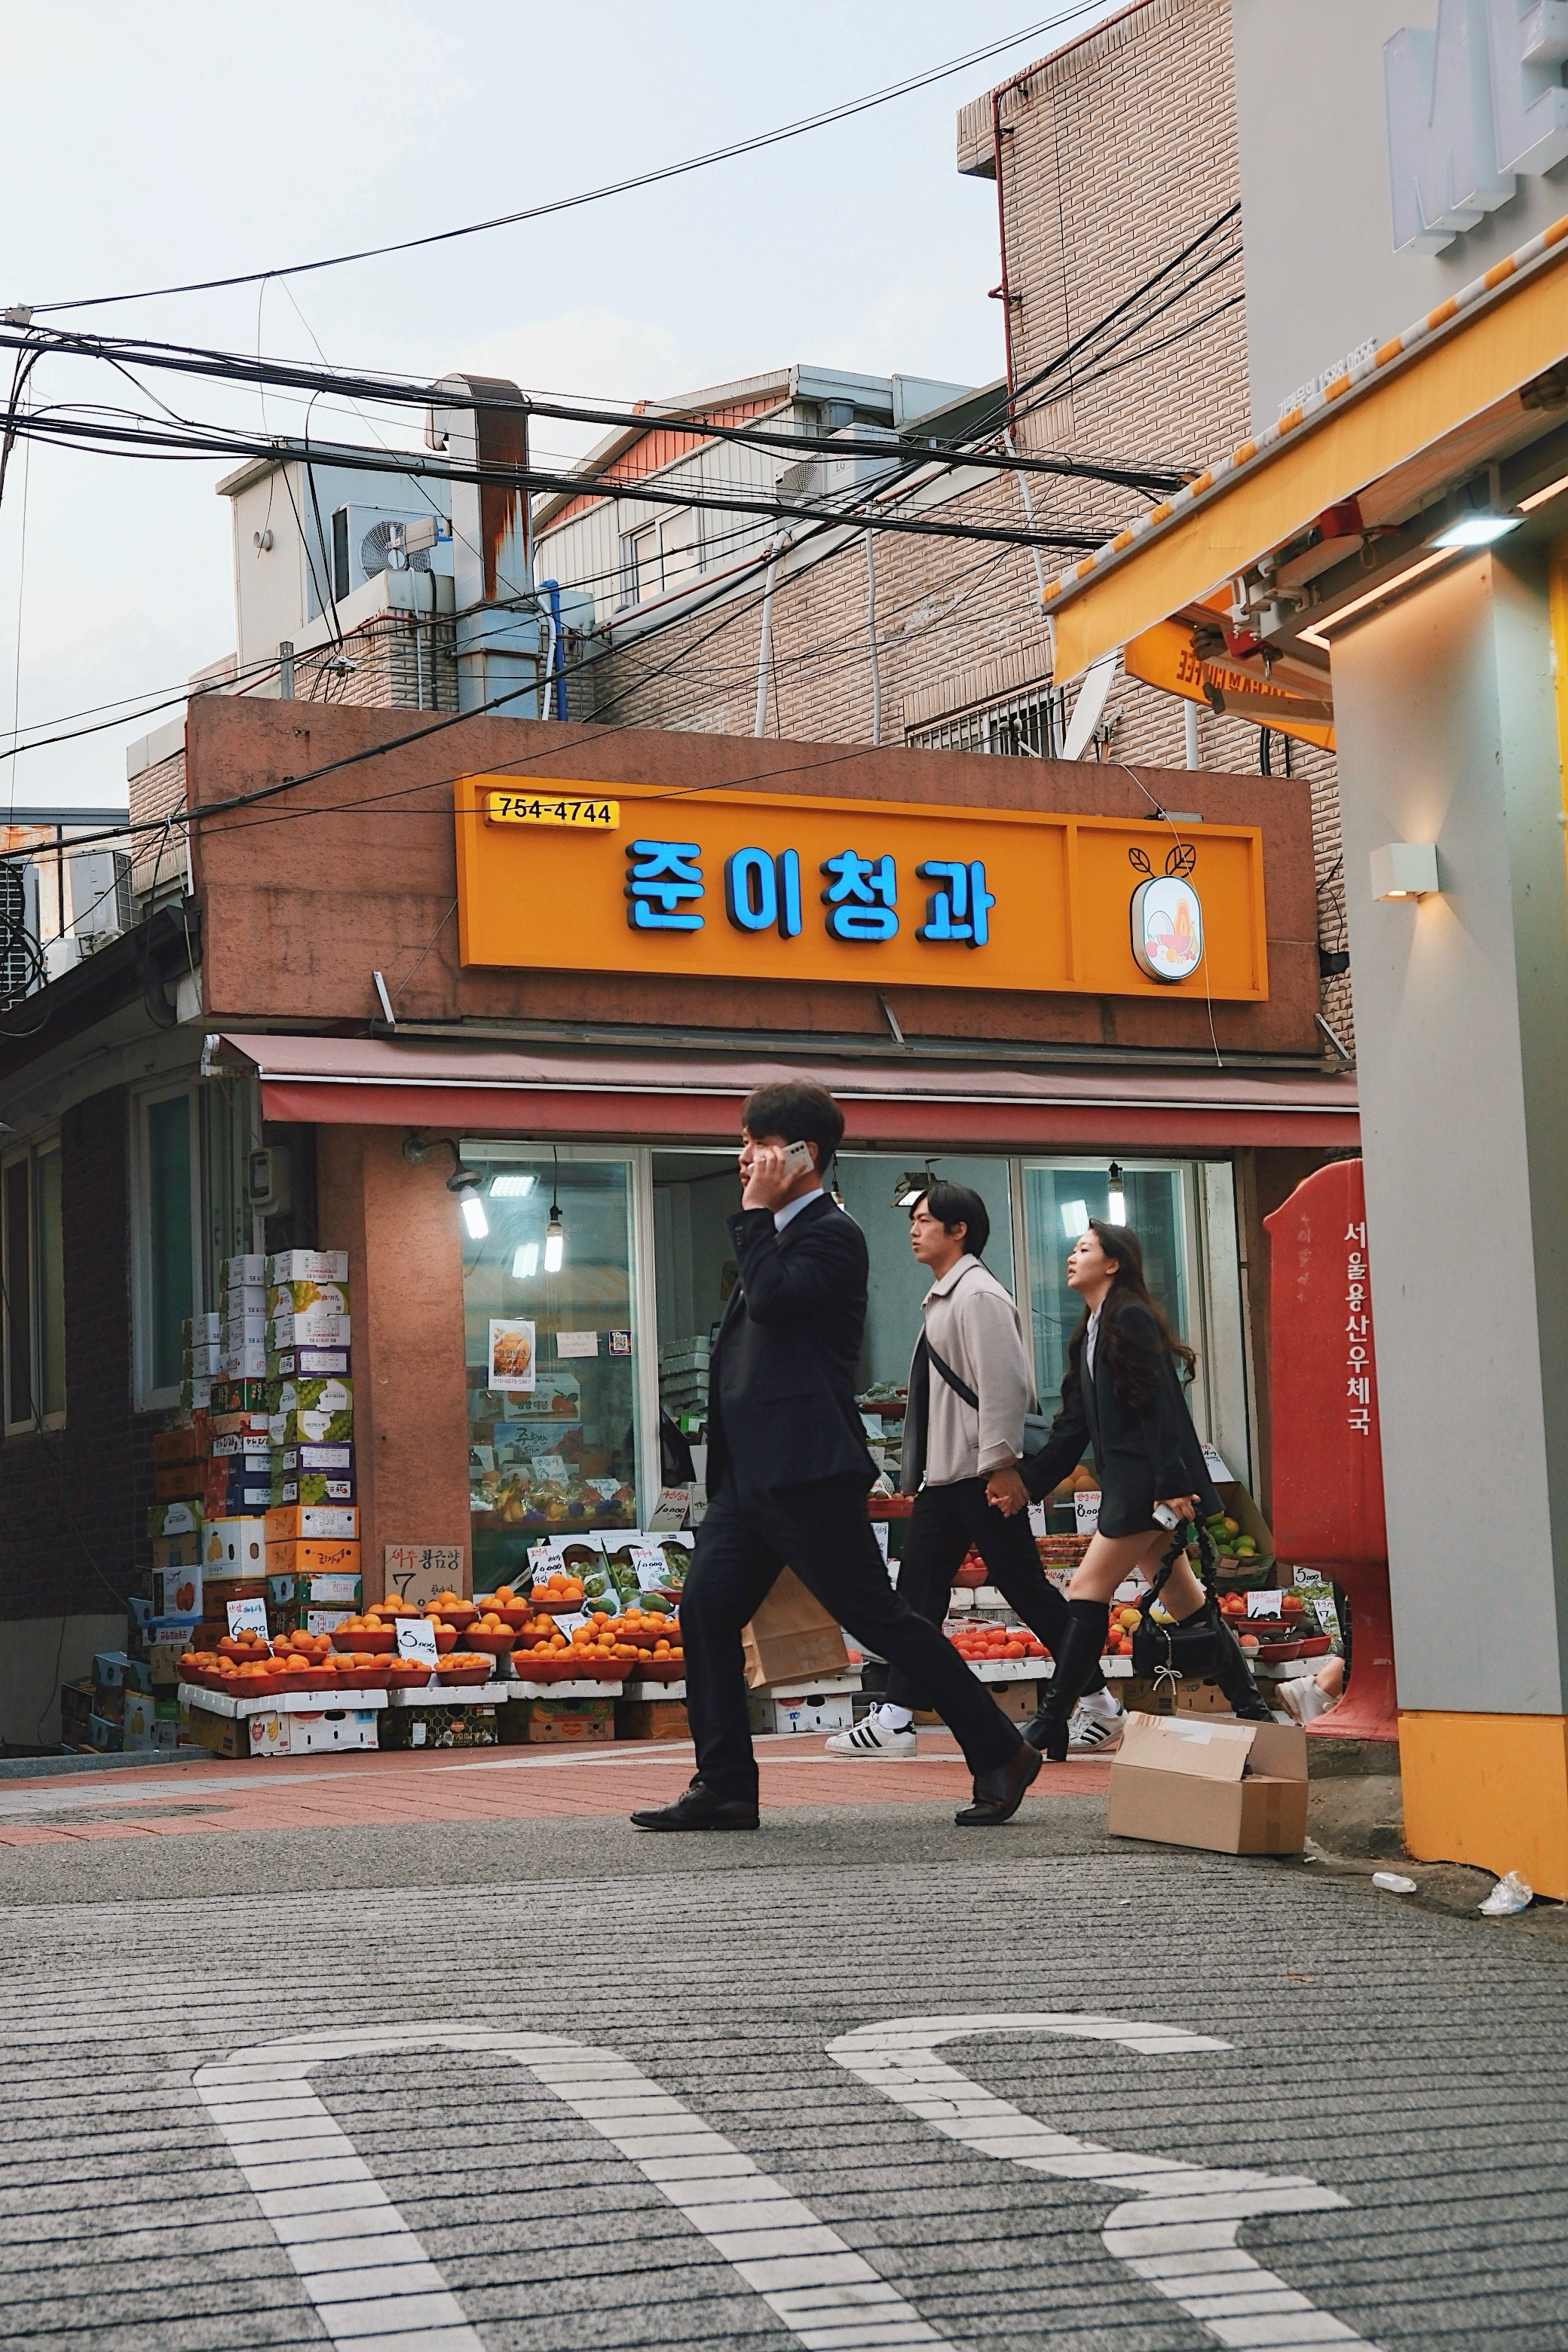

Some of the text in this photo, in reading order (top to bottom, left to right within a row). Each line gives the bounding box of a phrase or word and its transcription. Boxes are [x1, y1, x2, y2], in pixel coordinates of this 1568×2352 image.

[836, 461, 846, 473] LG
[498, 797, 612, 824] 754-4744
[626, 838, 996, 948] 준이청과
[1344, 1222, 1371, 1436] 서울용산우체국
[386, 1548, 462, 1570] 제주 황금향
